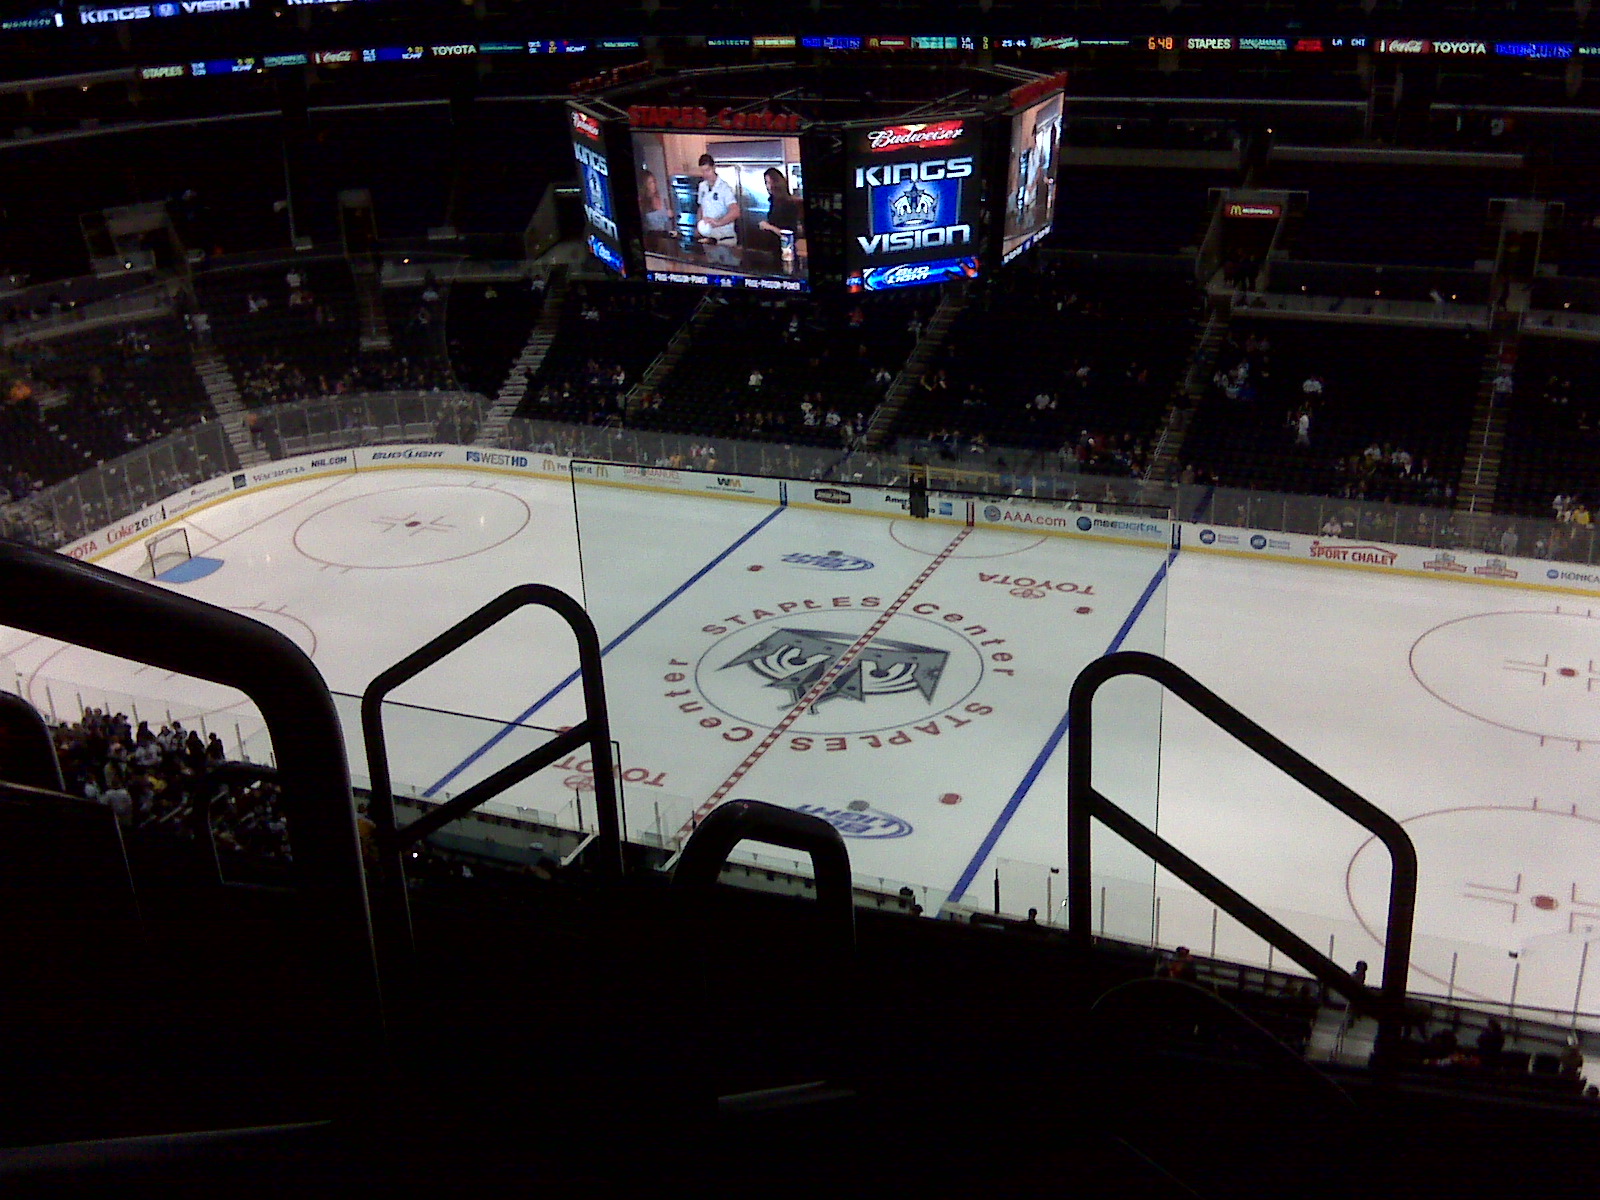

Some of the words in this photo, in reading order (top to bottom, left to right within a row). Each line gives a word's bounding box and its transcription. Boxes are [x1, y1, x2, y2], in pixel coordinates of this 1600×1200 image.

[80, 5, 151, 24] KINGS
[430, 44, 477, 56] TOYOTA
[1187, 37, 1231, 50] STAPLES
[1432, 41, 1487, 54] TOYOTA
[867, 127, 964, 149] Budweiser
[855, 156, 973, 188] KINGS
[857, 224, 970, 254] VISION
[887, 274, 929, 285] LIGHT
[896, 265, 930, 277] BUD
[311, 456, 348, 468] NHL.COM
[1004, 510, 1067, 528] AAA.com
[1309, 545, 1349, 561] SPORT
[1351, 551, 1398, 567] CHALET
[978, 571, 1096, 596] TOYOTA
[701, 596, 881, 636] STAPLES
[912, 602, 1015, 677] Center
[663, 657, 754, 742] Center
[789, 701, 993, 752] STAPLES
